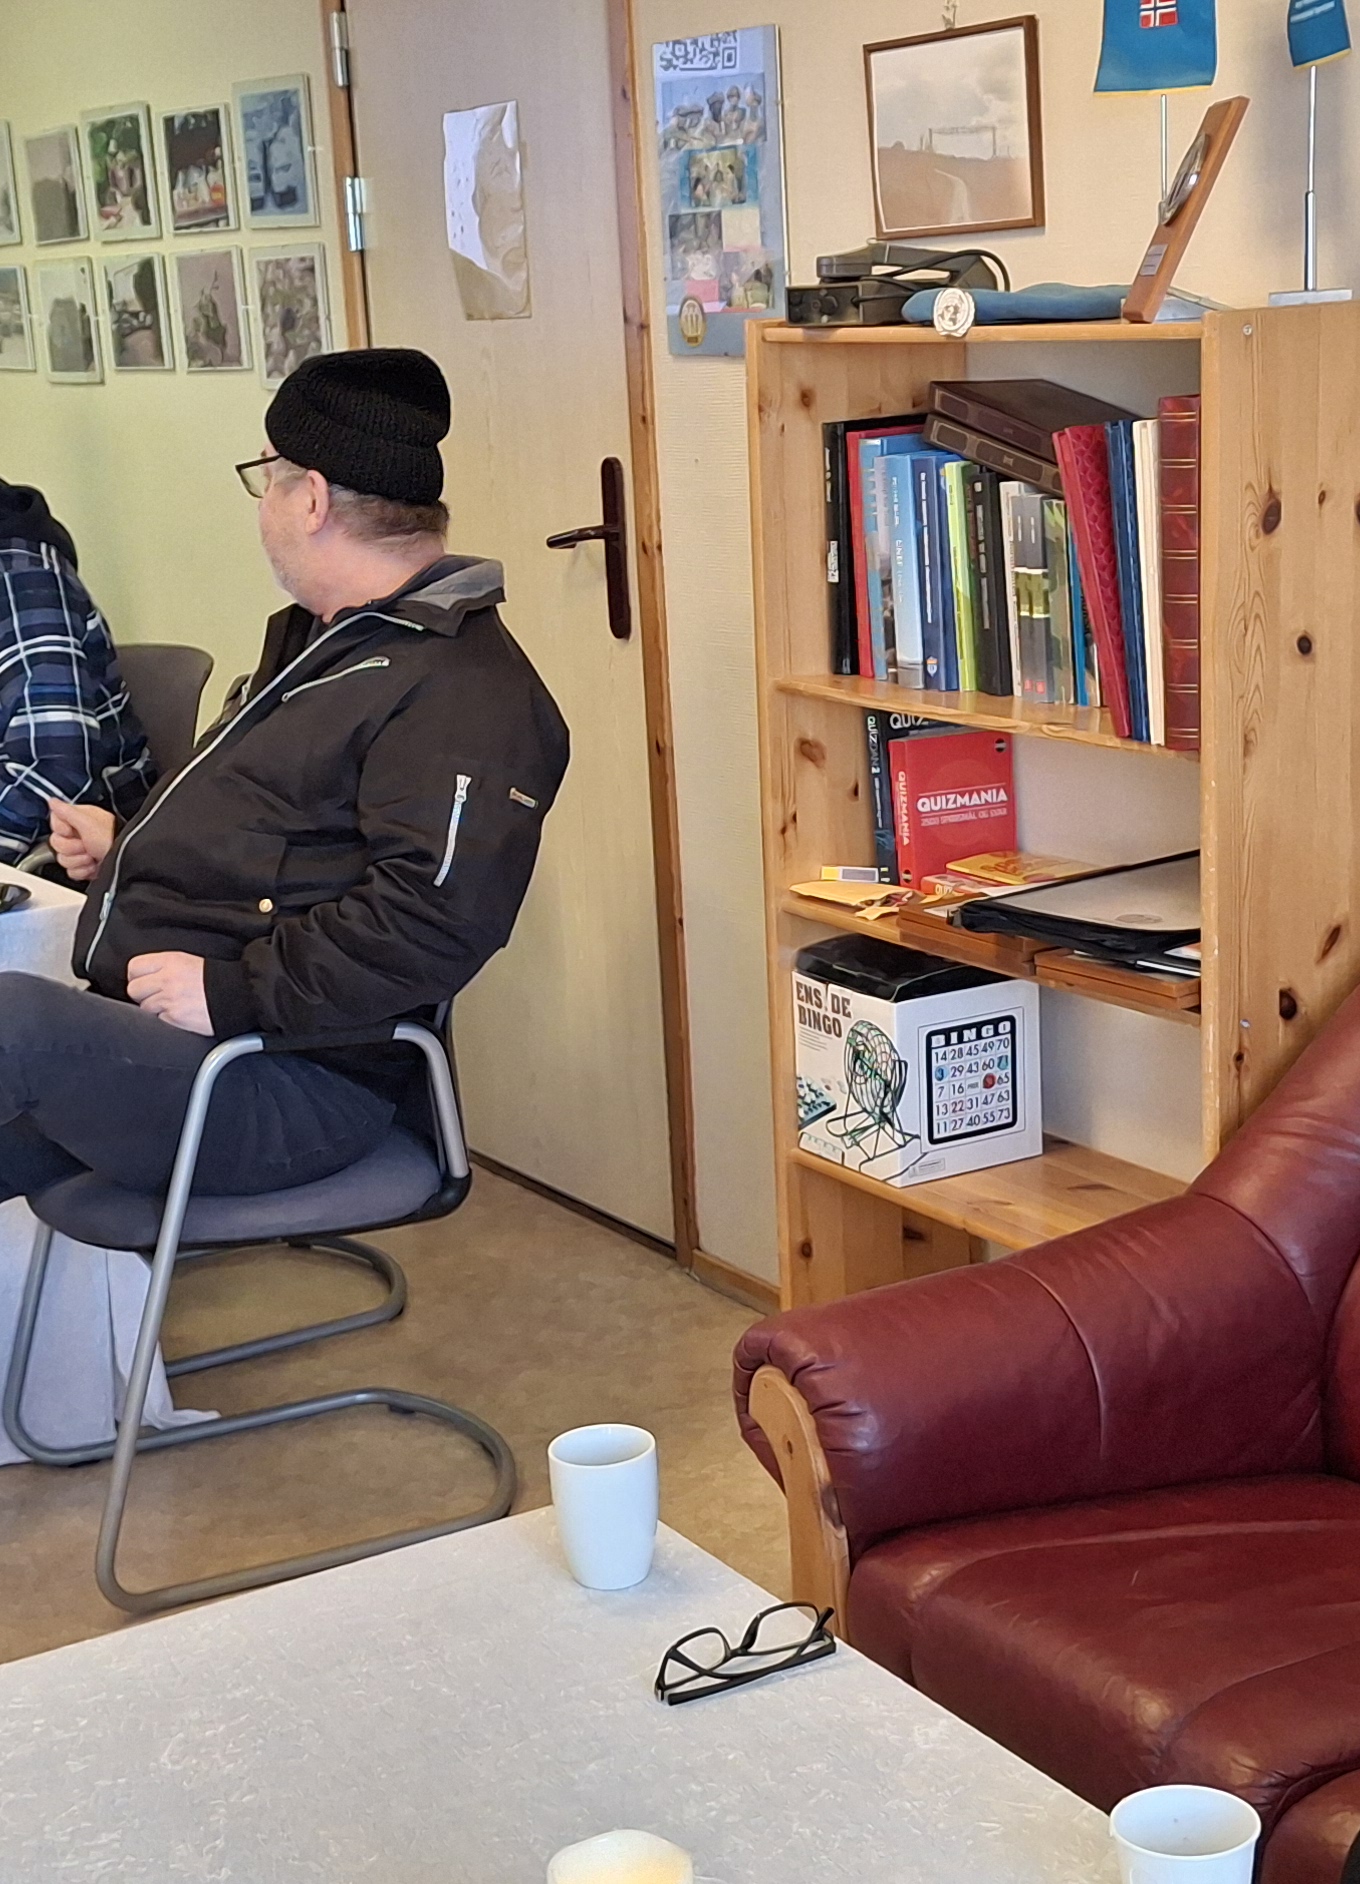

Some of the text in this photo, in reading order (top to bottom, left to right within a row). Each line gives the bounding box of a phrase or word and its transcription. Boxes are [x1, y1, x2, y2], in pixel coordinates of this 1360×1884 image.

[917, 787, 1008, 813] QUIZMANIA
[831, 993, 852, 1019] DE
[798, 1004, 843, 1038] BINGO
[935, 1037, 1010, 1064] 14 28 45 49 70
[950, 1065, 964, 1078] 29
[966, 1061, 980, 1074] 43
[981, 1058, 995, 1072] 60
[937, 1086, 945, 1099] 7
[952, 1083, 964, 1095] 16
[997, 1072, 1010, 1085] 65
[936, 1089, 1010, 1116] 13 22 31 47 63
[937, 1107, 1011, 1134] 11 27 40 55 73
